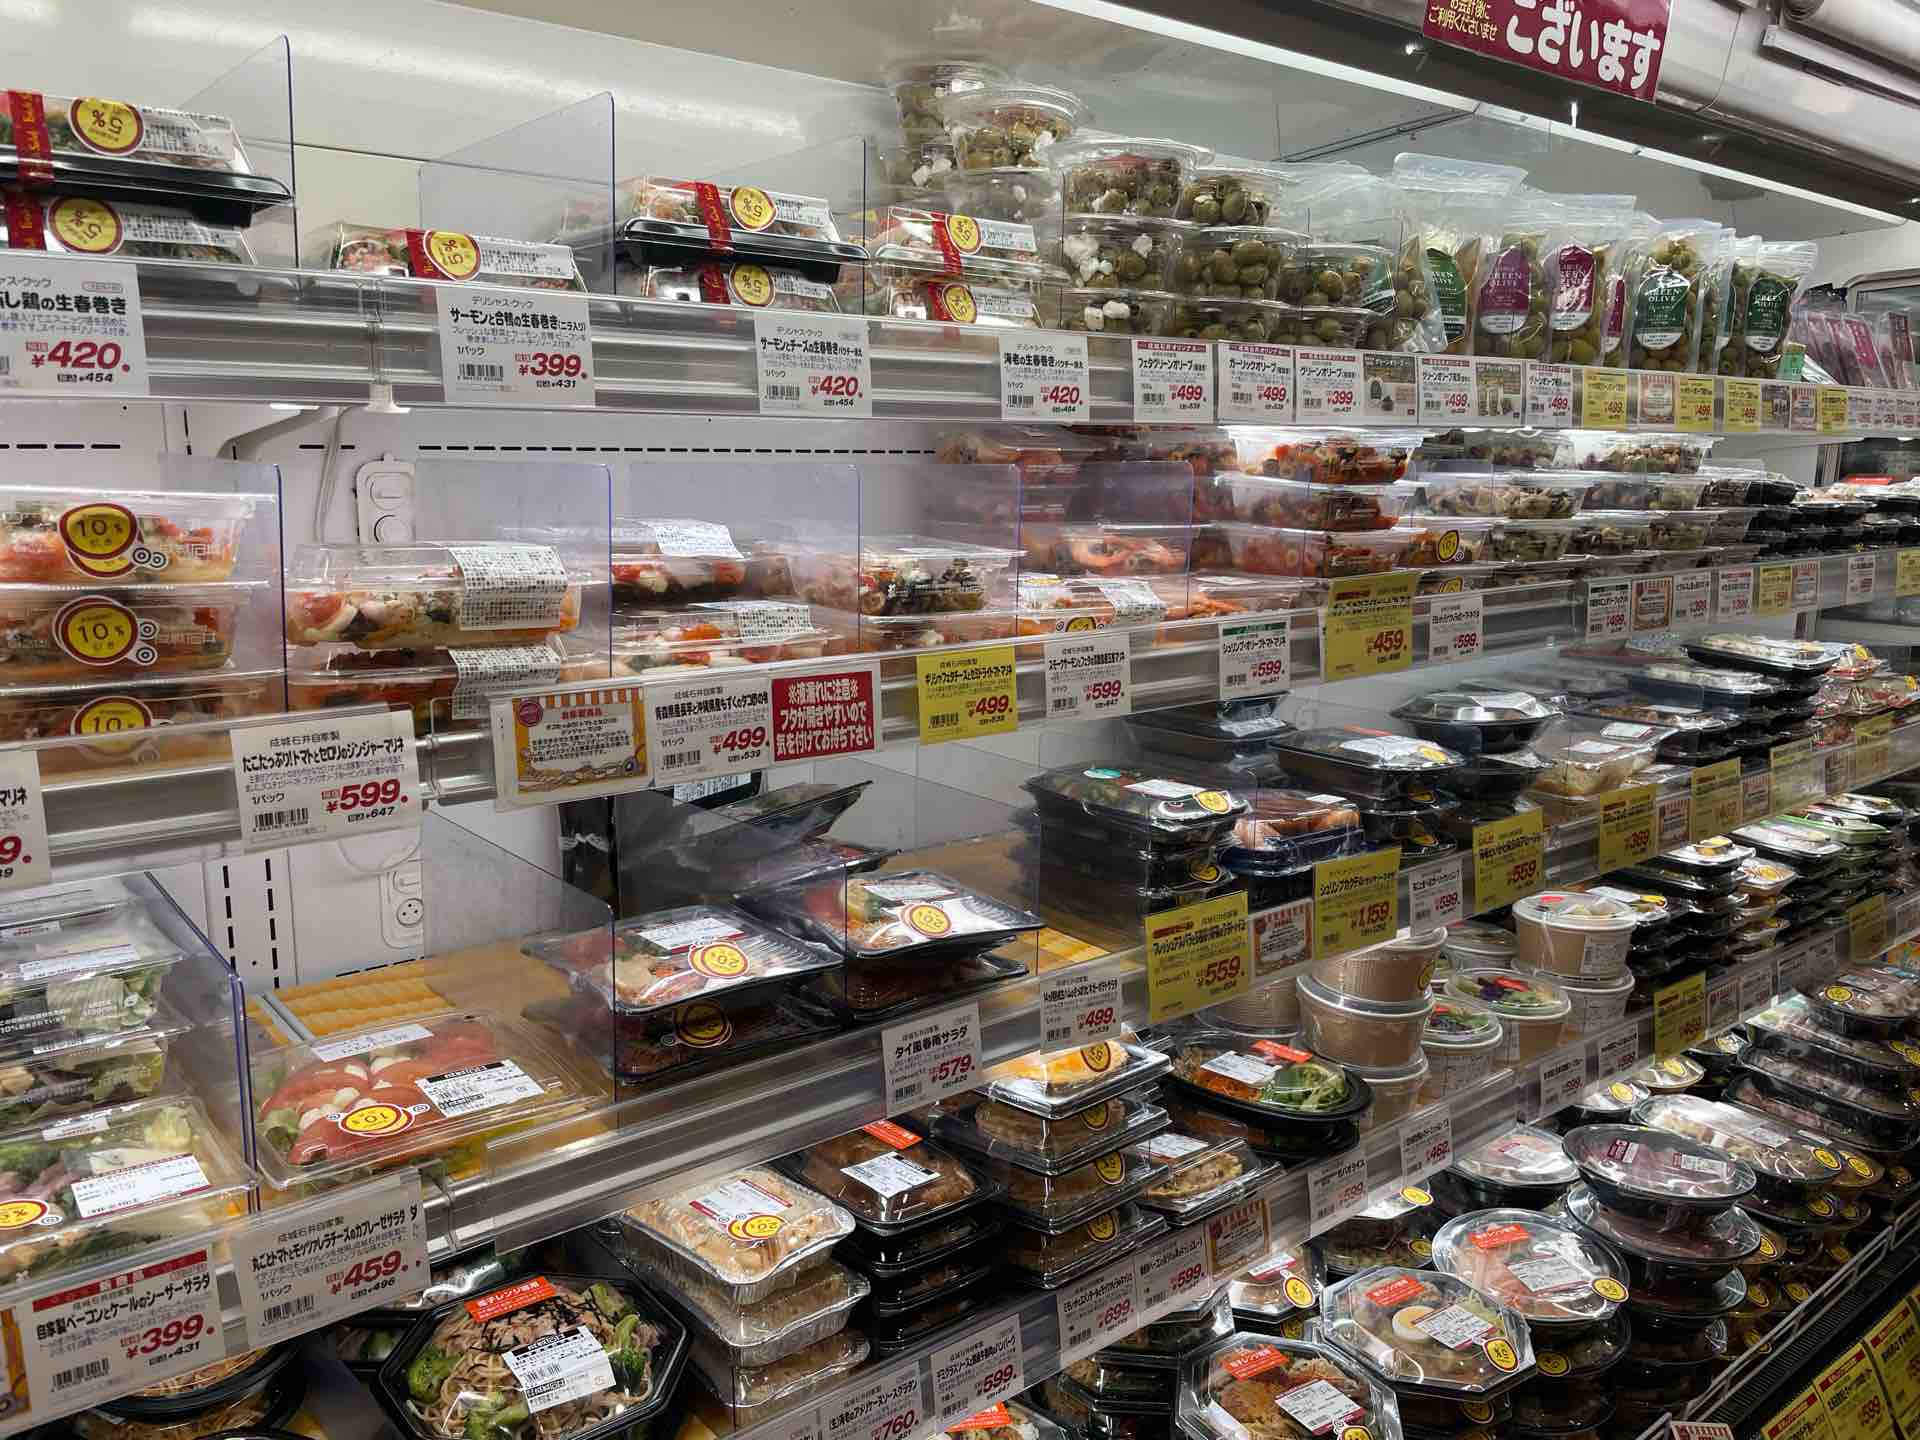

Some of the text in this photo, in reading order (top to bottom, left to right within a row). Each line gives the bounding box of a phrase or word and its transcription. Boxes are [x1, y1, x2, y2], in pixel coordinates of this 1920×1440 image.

[780, 700, 867, 731] フタが開きやすいので
[776, 725, 873, 757] 気を付けてお持ち下さい
